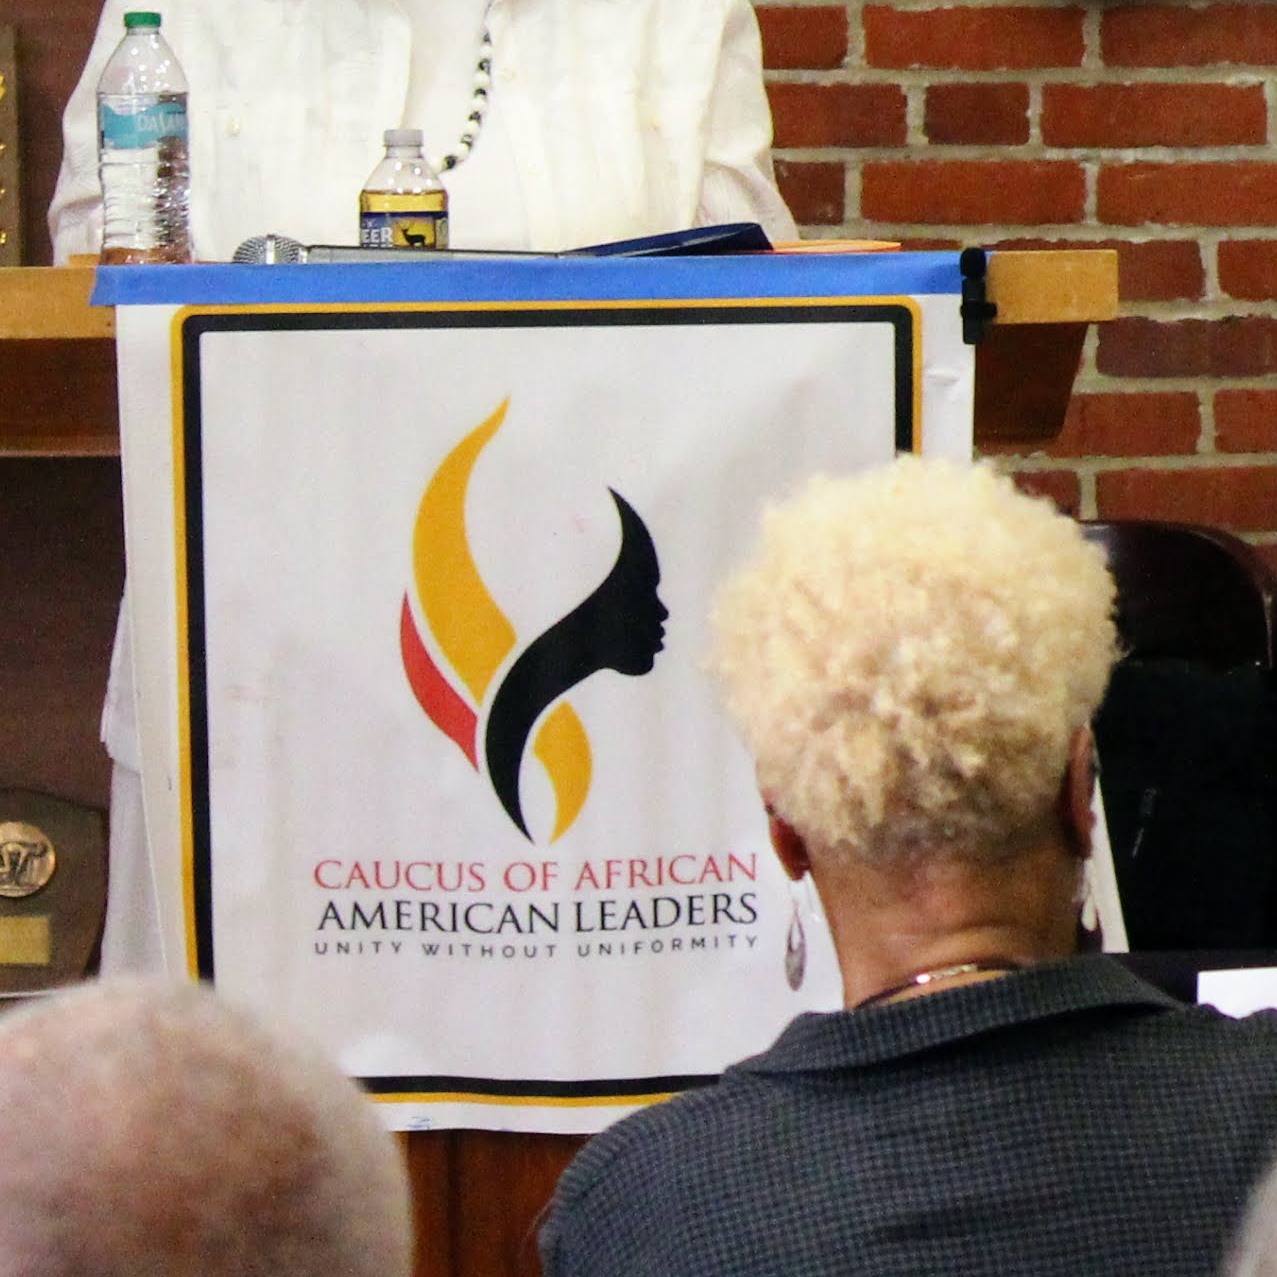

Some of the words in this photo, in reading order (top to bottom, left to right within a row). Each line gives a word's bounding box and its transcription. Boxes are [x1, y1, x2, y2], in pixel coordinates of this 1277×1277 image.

[360, 226, 394, 244] EER
[313, 858, 486, 892] CAUCUS
[502, 860, 559, 892] OF
[574, 852, 758, 891] AFRICAN
[317, 899, 560, 935] AMERICAN
[573, 892, 758, 933] LEADERS
[314, 940, 403, 956] UNITY
[421, 942, 558, 959] WITHOUT
[577, 934, 758, 958] UNIFORMITY
